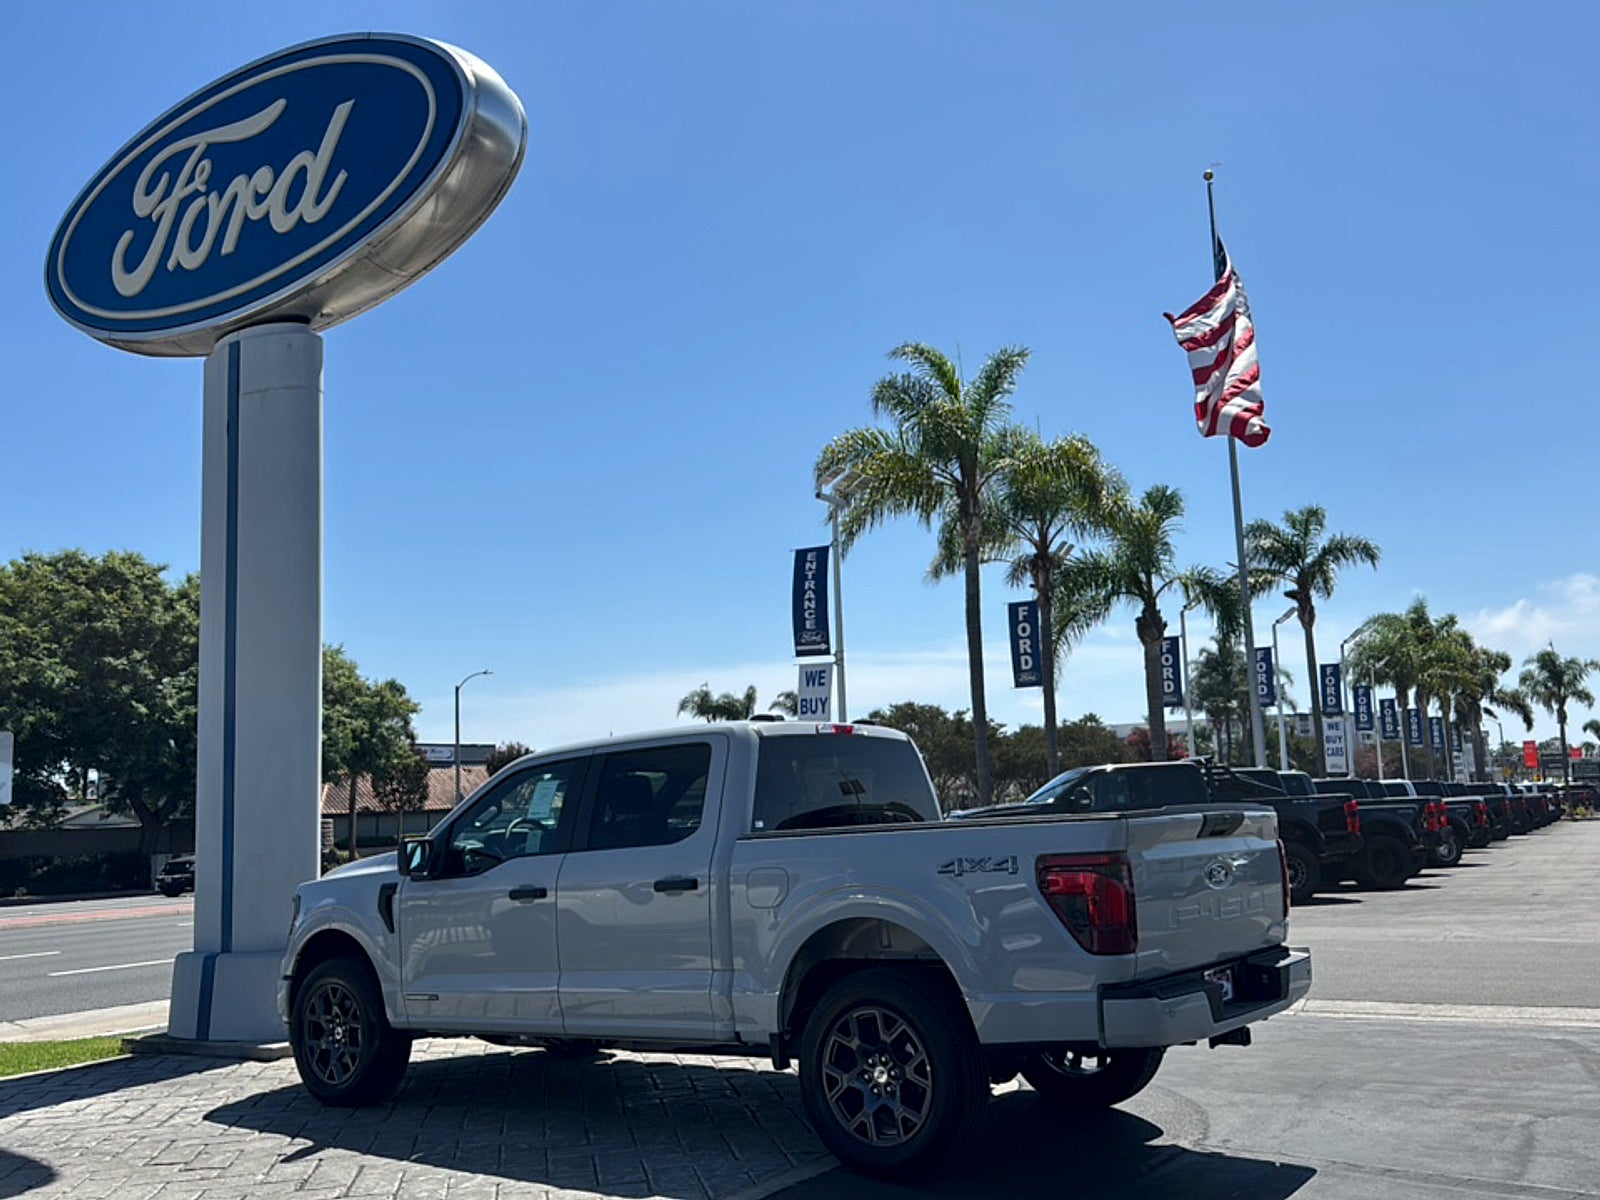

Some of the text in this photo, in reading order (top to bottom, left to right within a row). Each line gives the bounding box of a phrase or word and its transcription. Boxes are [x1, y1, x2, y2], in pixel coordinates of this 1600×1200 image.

[111, 98, 355, 298] Ford
[804, 551, 817, 630] ENTRANCE
[1017, 606, 1033, 670] FORD
[805, 669, 826, 687] WE
[1162, 641, 1174, 693] FORD
[1256, 650, 1268, 695] FORD
[1325, 667, 1336, 706] FORD
[800, 697, 828, 714] BUY
[1358, 688, 1368, 721] FORD
[1383, 701, 1393, 731] FORD
[1325, 735, 1342, 744] BUY
[1327, 722, 1340, 731] WE
[1326, 746, 1344, 757] CARS
